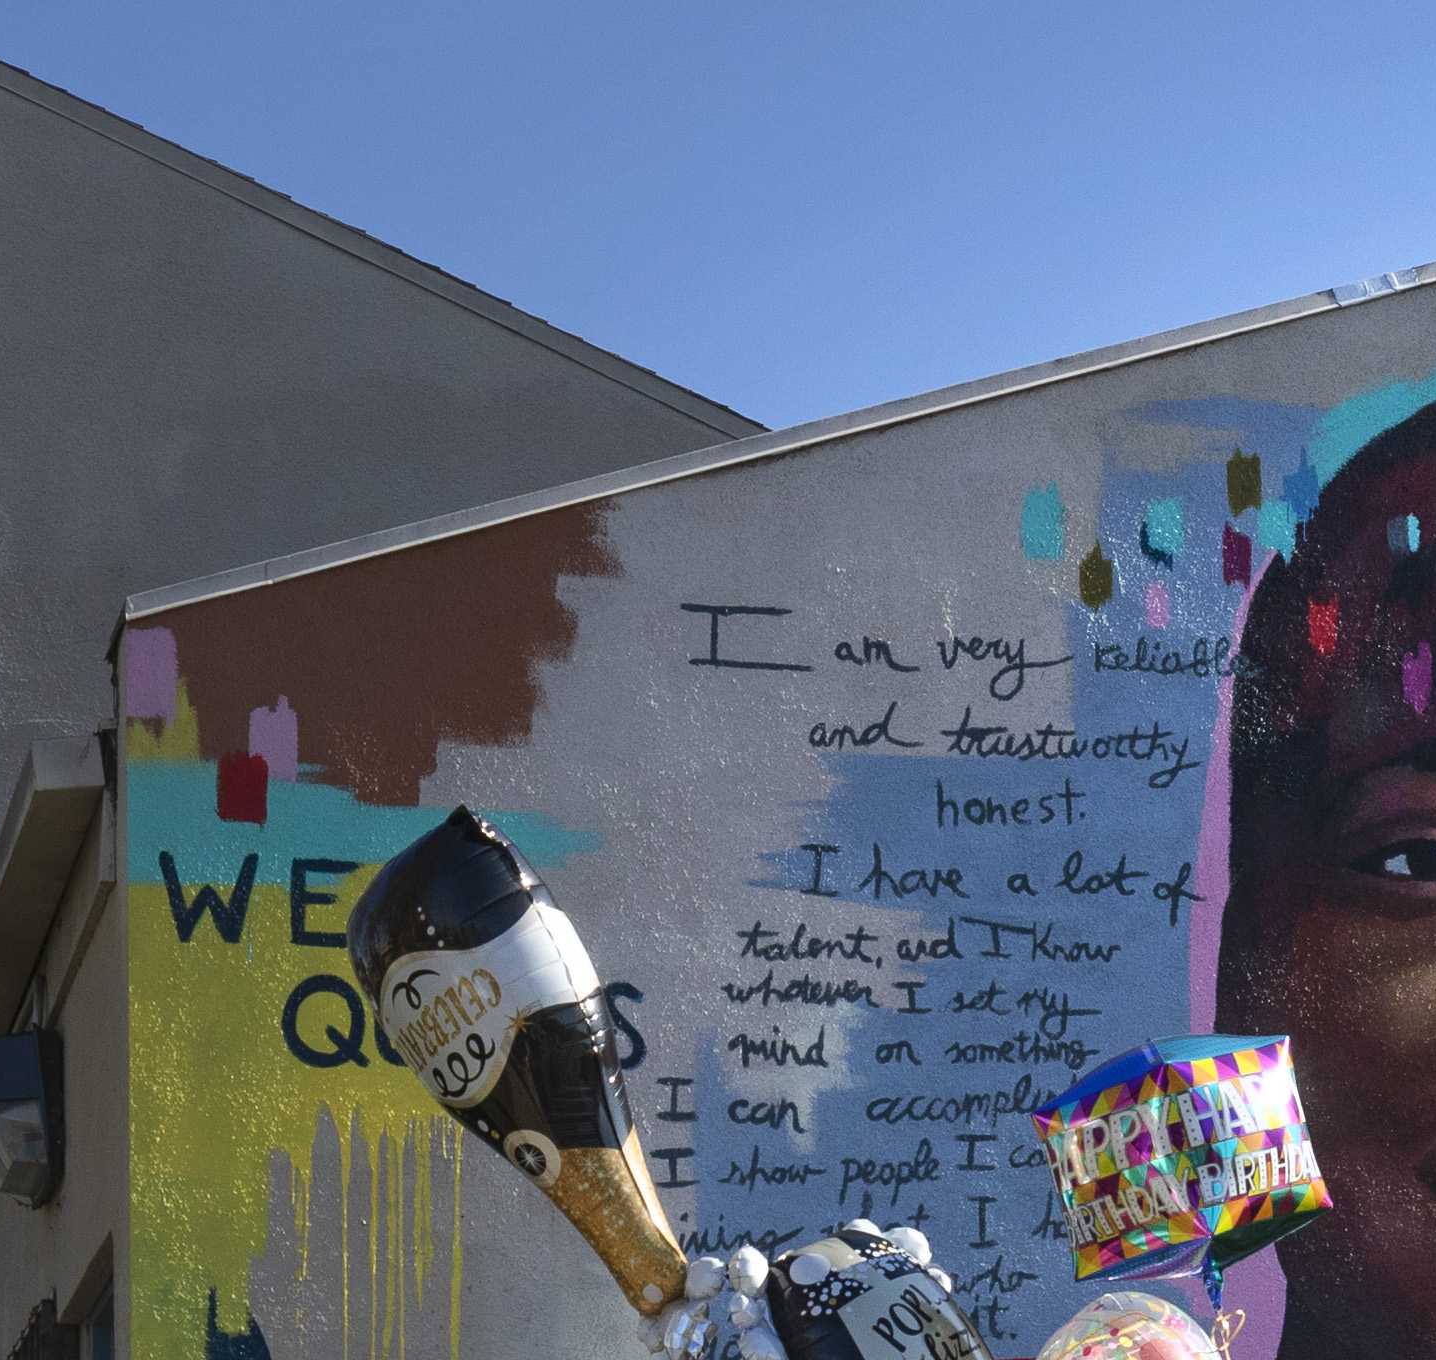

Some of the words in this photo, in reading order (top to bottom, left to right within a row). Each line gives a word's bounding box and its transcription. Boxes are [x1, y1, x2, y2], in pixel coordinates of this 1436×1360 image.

[681, 602, 814, 672] I
[834, 635, 920, 673] am
[937, 634, 1074, 701] very
[809, 700, 925, 751] and
[940, 704, 1202, 789] trustworthy
[935, 778, 1086, 827] honest.
[799, 843, 842, 898] I
[858, 842, 971, 899] have
[1006, 872, 1040, 898] a
[1057, 850, 1149, 897] lot
[1152, 862, 1207, 927] of
[896, 916, 964, 963] and
[960, 916, 1035, 959] I
[891, 981, 932, 1014] I
[950, 979, 1014, 1016] set
[1016, 986, 1102, 1041] my
[727, 1024, 829, 1068] mind
[875, 1040, 923, 1066] on
[944, 1030, 1100, 1070] something
[655, 1077, 697, 1122] I
[727, 1098, 809, 1134] can
[649, 1147, 700, 1188] I
[718, 1144, 827, 1191] show
[839, 1138, 941, 1206] people
[955, 1134, 999, 1171] I
[1043, 1094, 1172, 1193] HAPPY
[967, 1195, 999, 1248] I
[1065, 1166, 1192, 1248] BIRTHDAY
